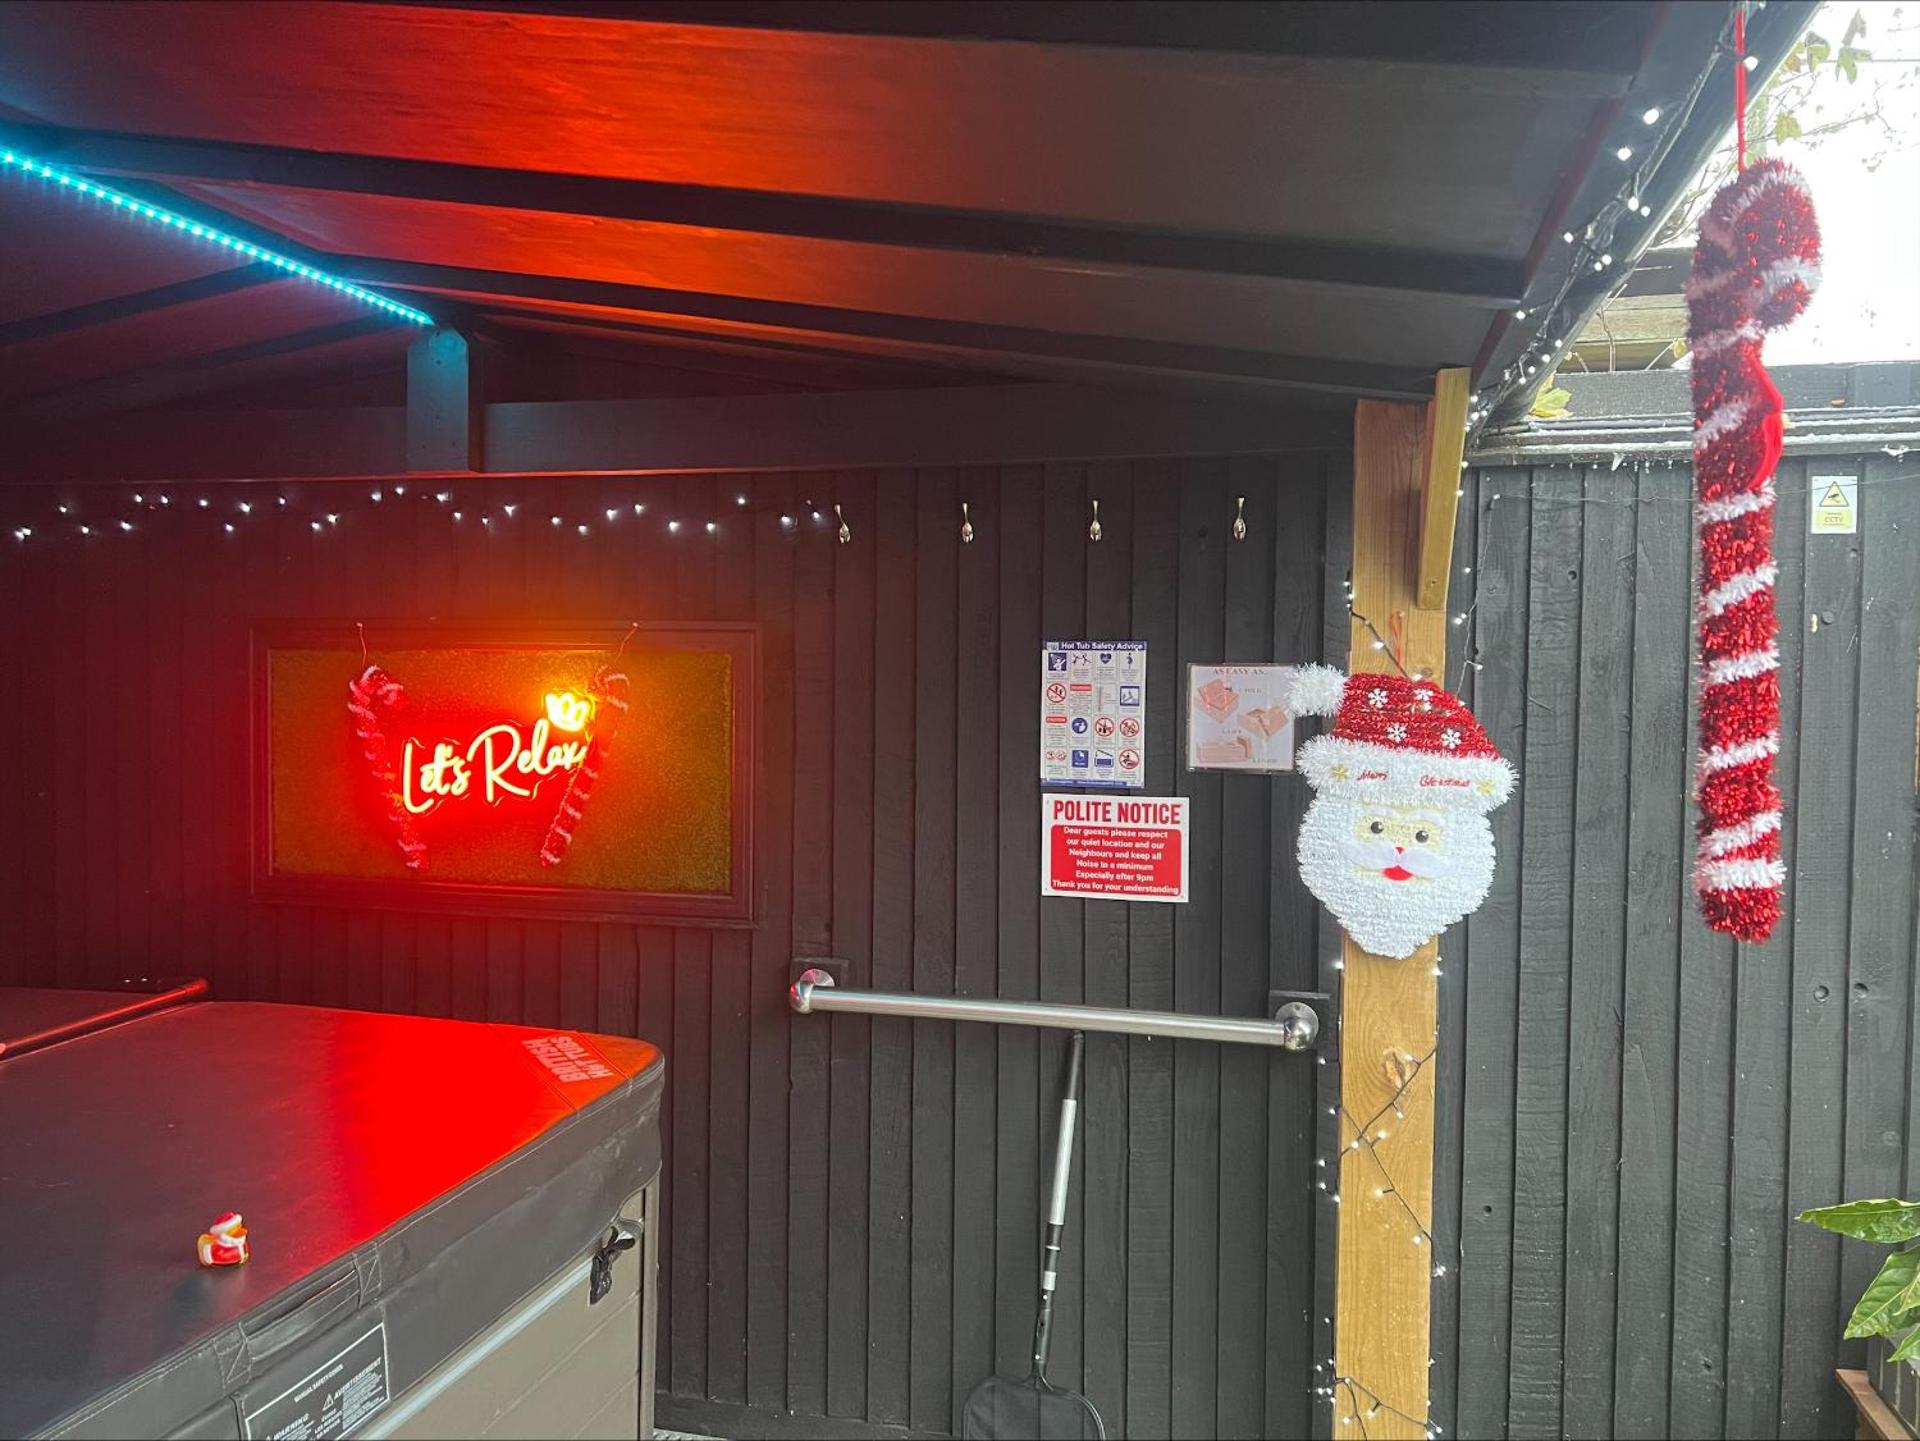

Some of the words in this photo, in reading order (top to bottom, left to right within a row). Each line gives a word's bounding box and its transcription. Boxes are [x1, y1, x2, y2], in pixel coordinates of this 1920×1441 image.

[1061, 642, 1074, 650] Hot
[1076, 642, 1090, 650] Tub
[1091, 642, 1116, 651] Safety
[1116, 643, 1144, 651] Advice
[403, 742, 471, 813] Let's
[466, 718, 587, 803] Relax
[1054, 799, 1111, 822] POLITE
[1117, 802, 1181, 824] NOTICE
[1064, 826, 1081, 834] Dear
[1083, 828, 1109, 837] guests
[1111, 829, 1136, 838] please
[1138, 831, 1168, 839] respect
[1081, 839, 1100, 848] quiet
[1102, 839, 1133, 848] location
[1135, 841, 1149, 849] and
[1069, 848, 1113, 859] Neighbours
[1115, 850, 1129, 858] and
[1131, 851, 1150, 861] keep
[1152, 852, 1162, 860] all
[1077, 859, 1098, 868] Noise
[1116, 862, 1154, 871] minimum
[1076, 870, 1114, 880] Especially
[1115, 871, 1135, 880] after
[1136, 873, 1154, 882] 9pm
[1053, 880, 1075, 888] Thank
[1077, 882, 1091, 890] you
[1104, 884, 1122, 892] your
[1123, 884, 1179, 894] understanding
[549, 1036, 590, 1060] TUBS
[521, 1038, 591, 1082] BRITISH
[273, 1413, 309, 1440] WARNING
